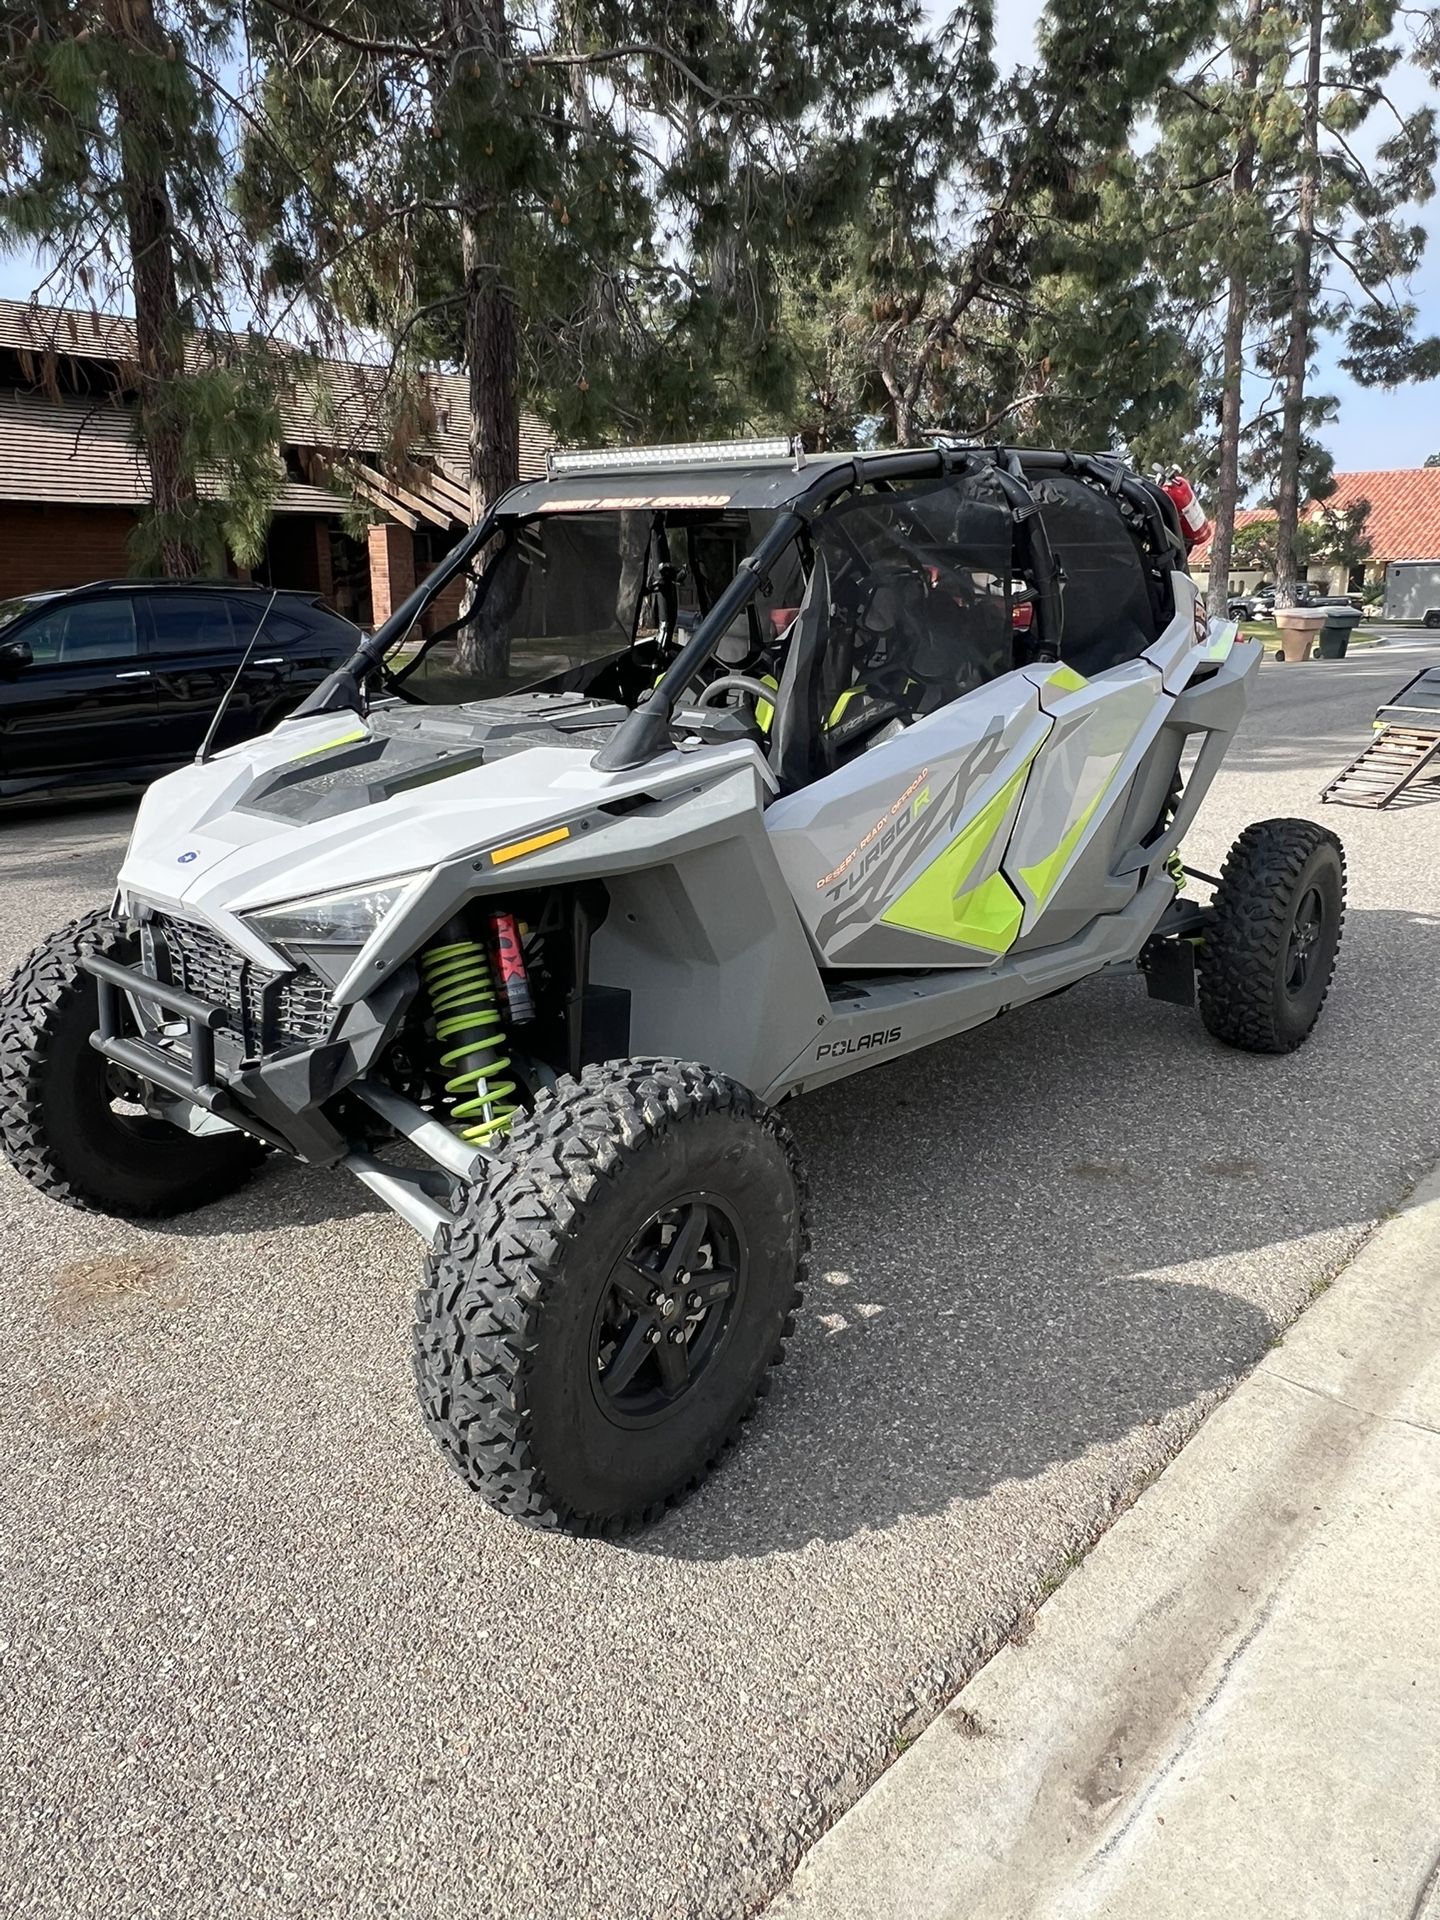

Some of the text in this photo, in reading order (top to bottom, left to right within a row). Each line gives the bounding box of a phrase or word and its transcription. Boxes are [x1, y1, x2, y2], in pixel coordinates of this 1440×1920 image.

[815, 767, 929, 891] DESERT READY OFFROAD
[816, 1026, 902, 1061] POLARIS
